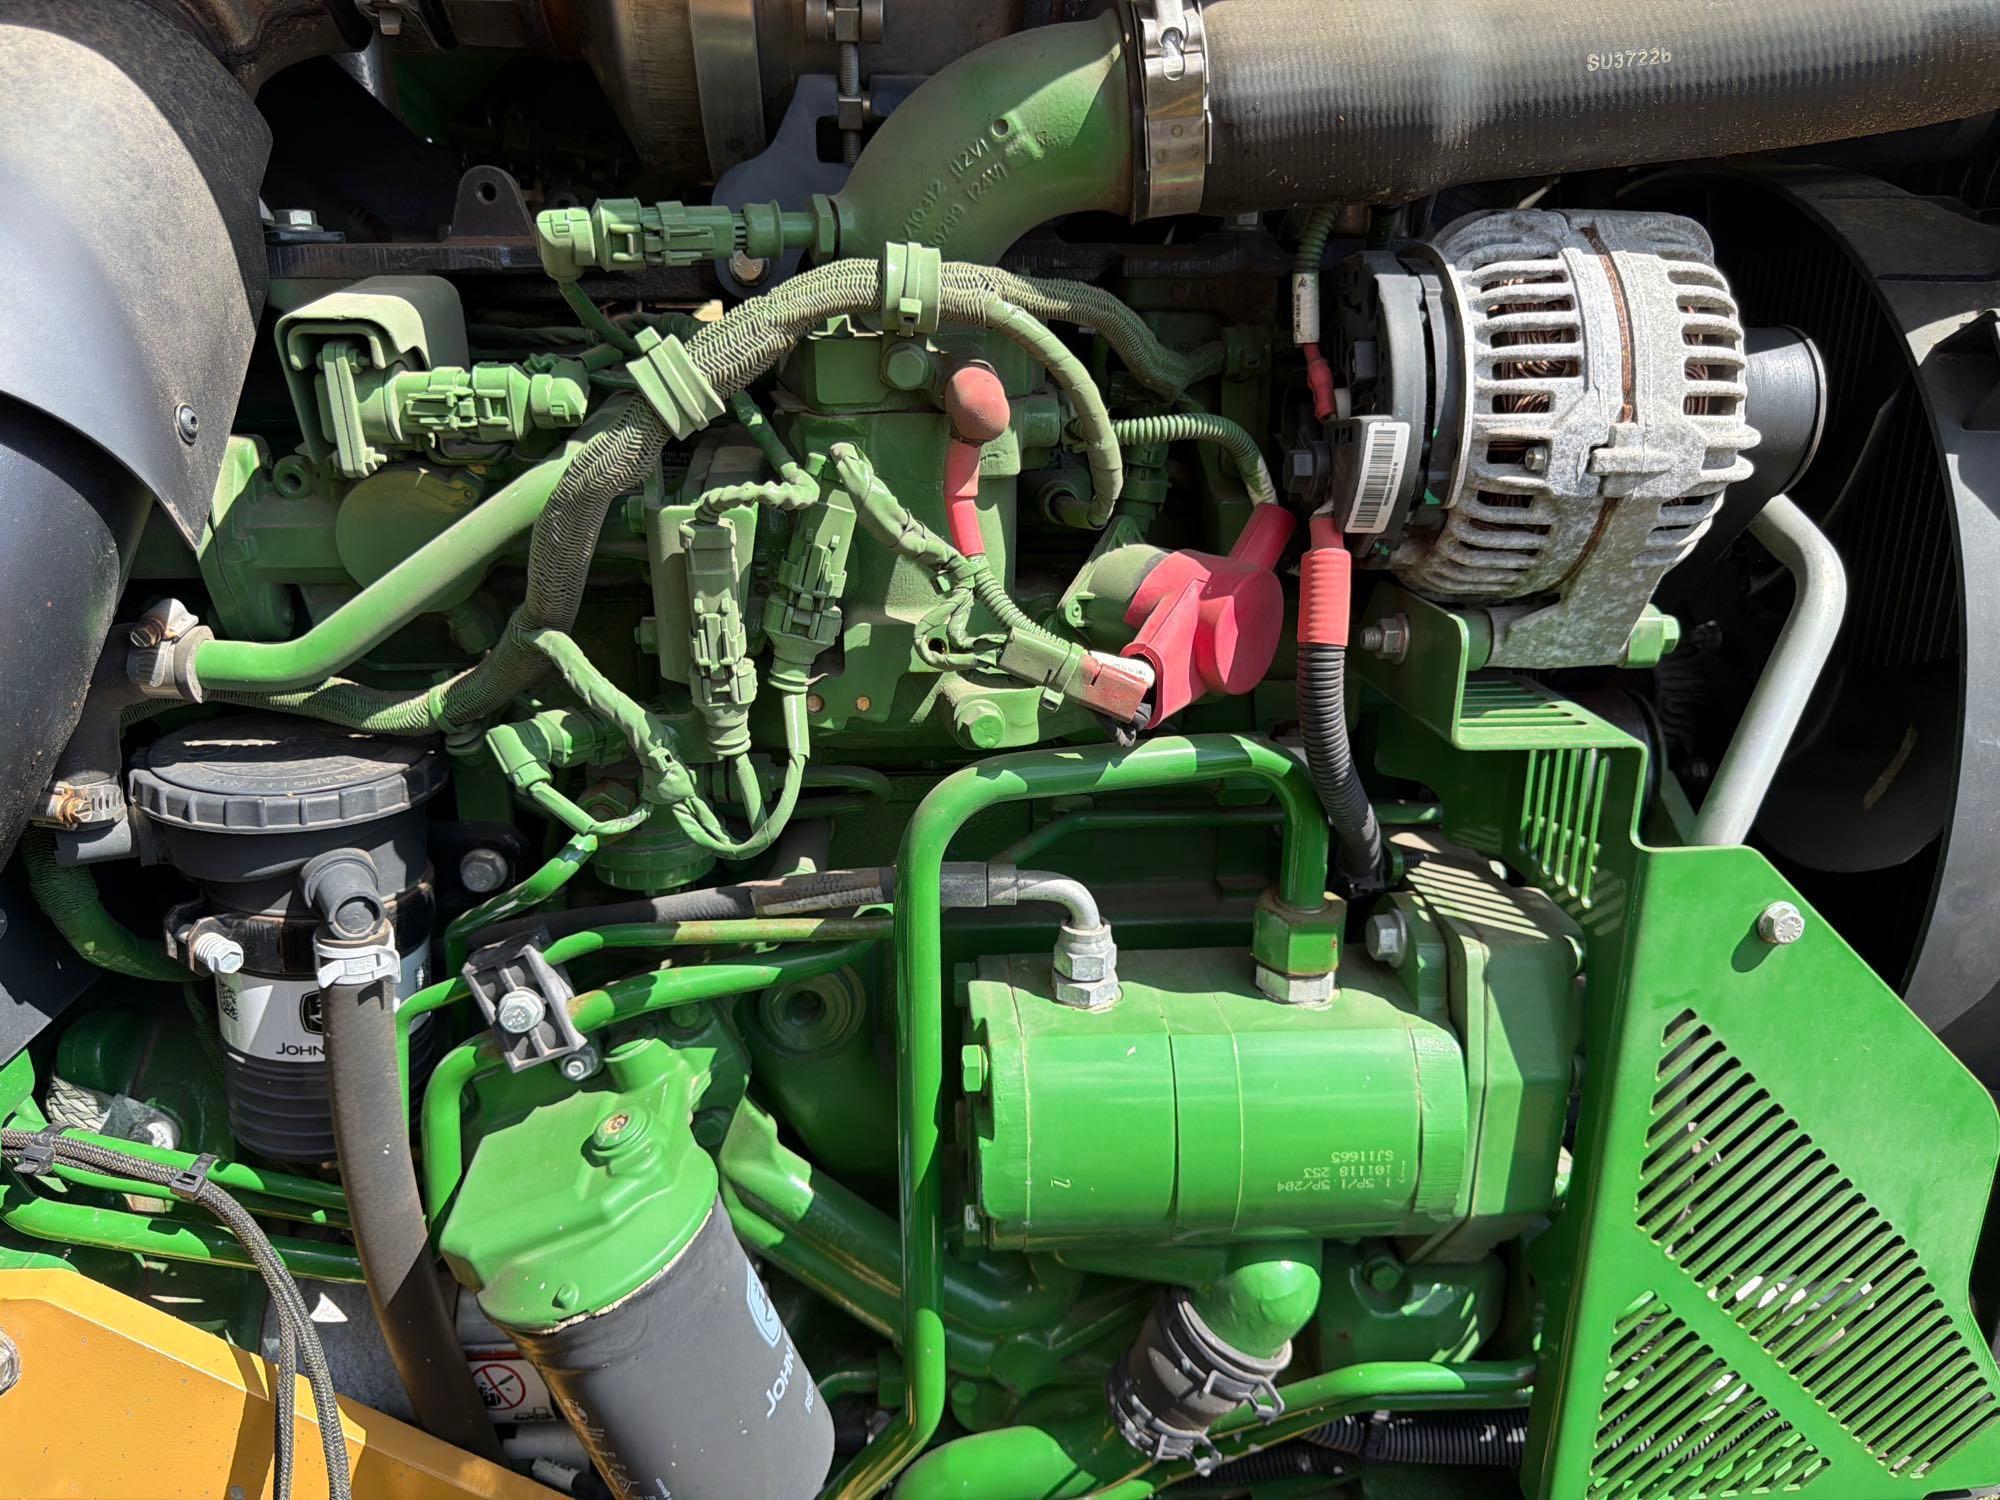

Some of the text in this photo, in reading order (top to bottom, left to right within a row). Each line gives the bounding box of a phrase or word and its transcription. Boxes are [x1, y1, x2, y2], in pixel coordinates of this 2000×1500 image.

[276, 1042, 325, 1056] JOHN
[1331, 1150, 1394, 1164] SJ11665
[1303, 1164, 1392, 1179] 101118 253
[766, 1344, 795, 1418] JOHN
